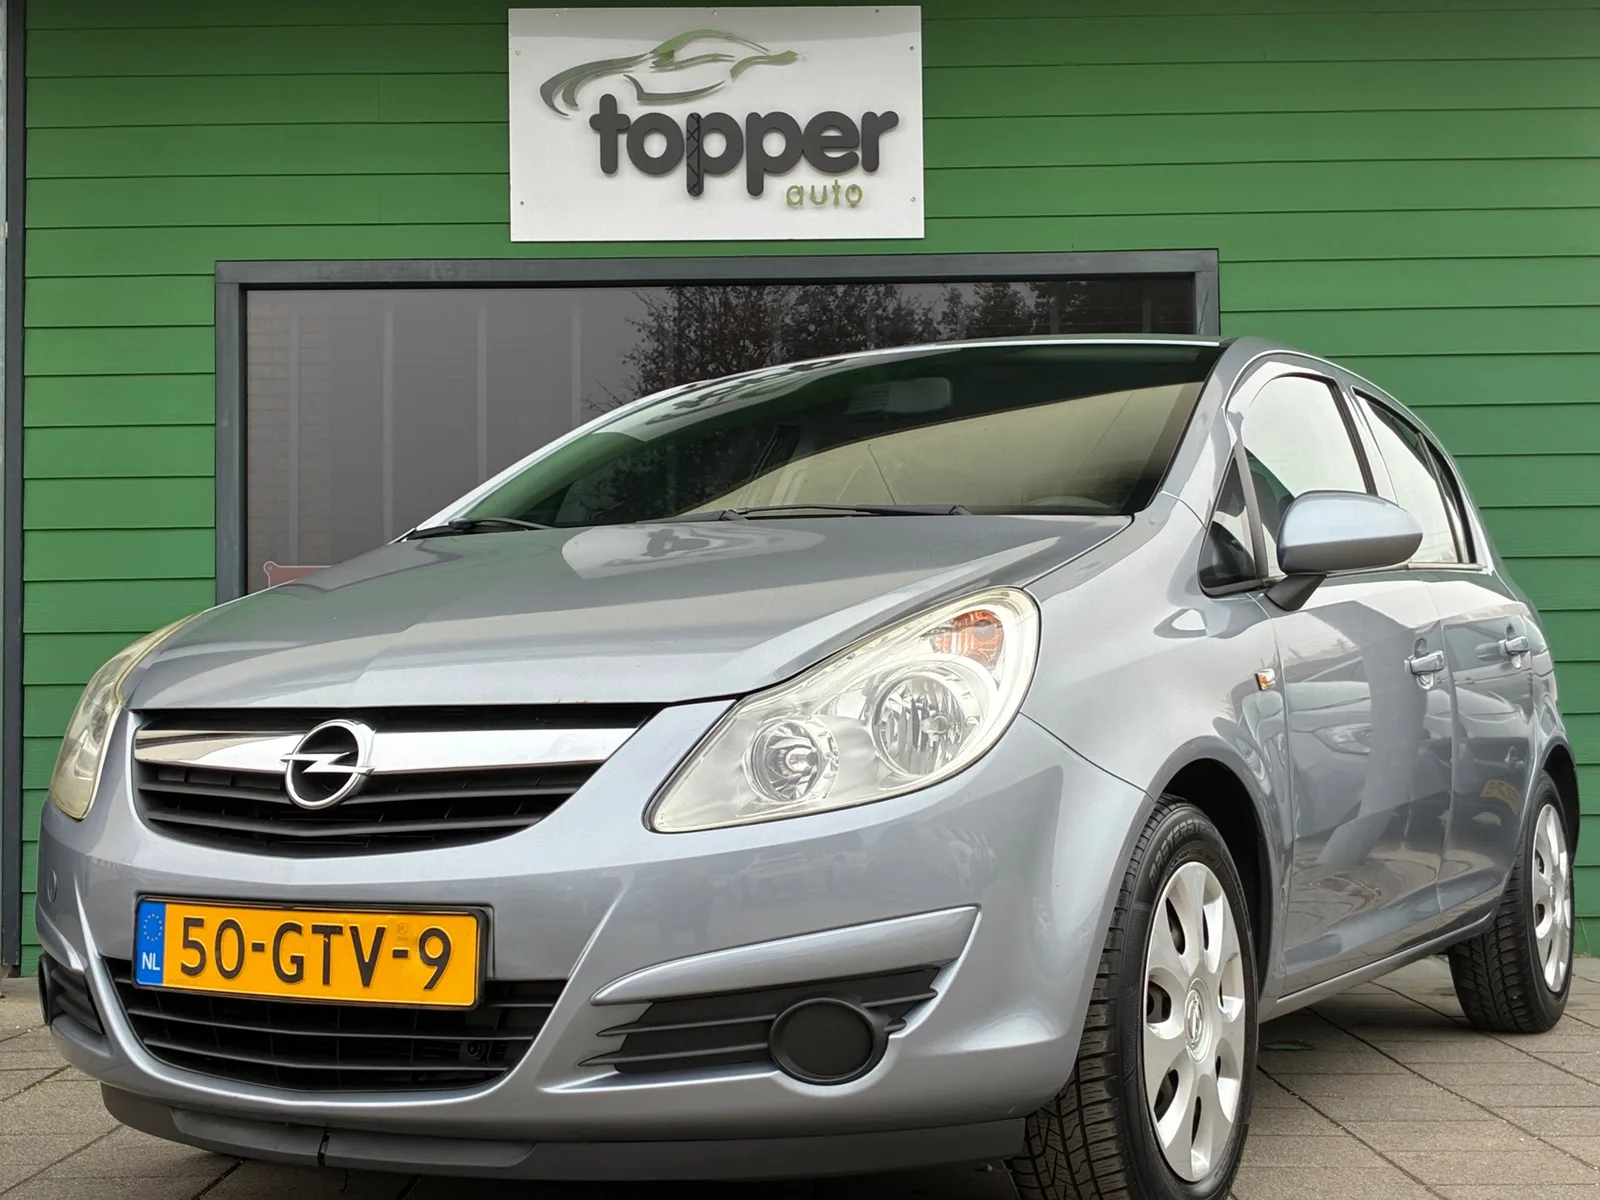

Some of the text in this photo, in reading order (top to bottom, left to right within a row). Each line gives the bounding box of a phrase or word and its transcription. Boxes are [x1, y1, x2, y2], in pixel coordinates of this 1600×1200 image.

[589, 93, 899, 197] topper
[786, 179, 863, 207] auto
[142, 952, 160, 971] NL
[180, 916, 453, 990] 50-GTV-9
